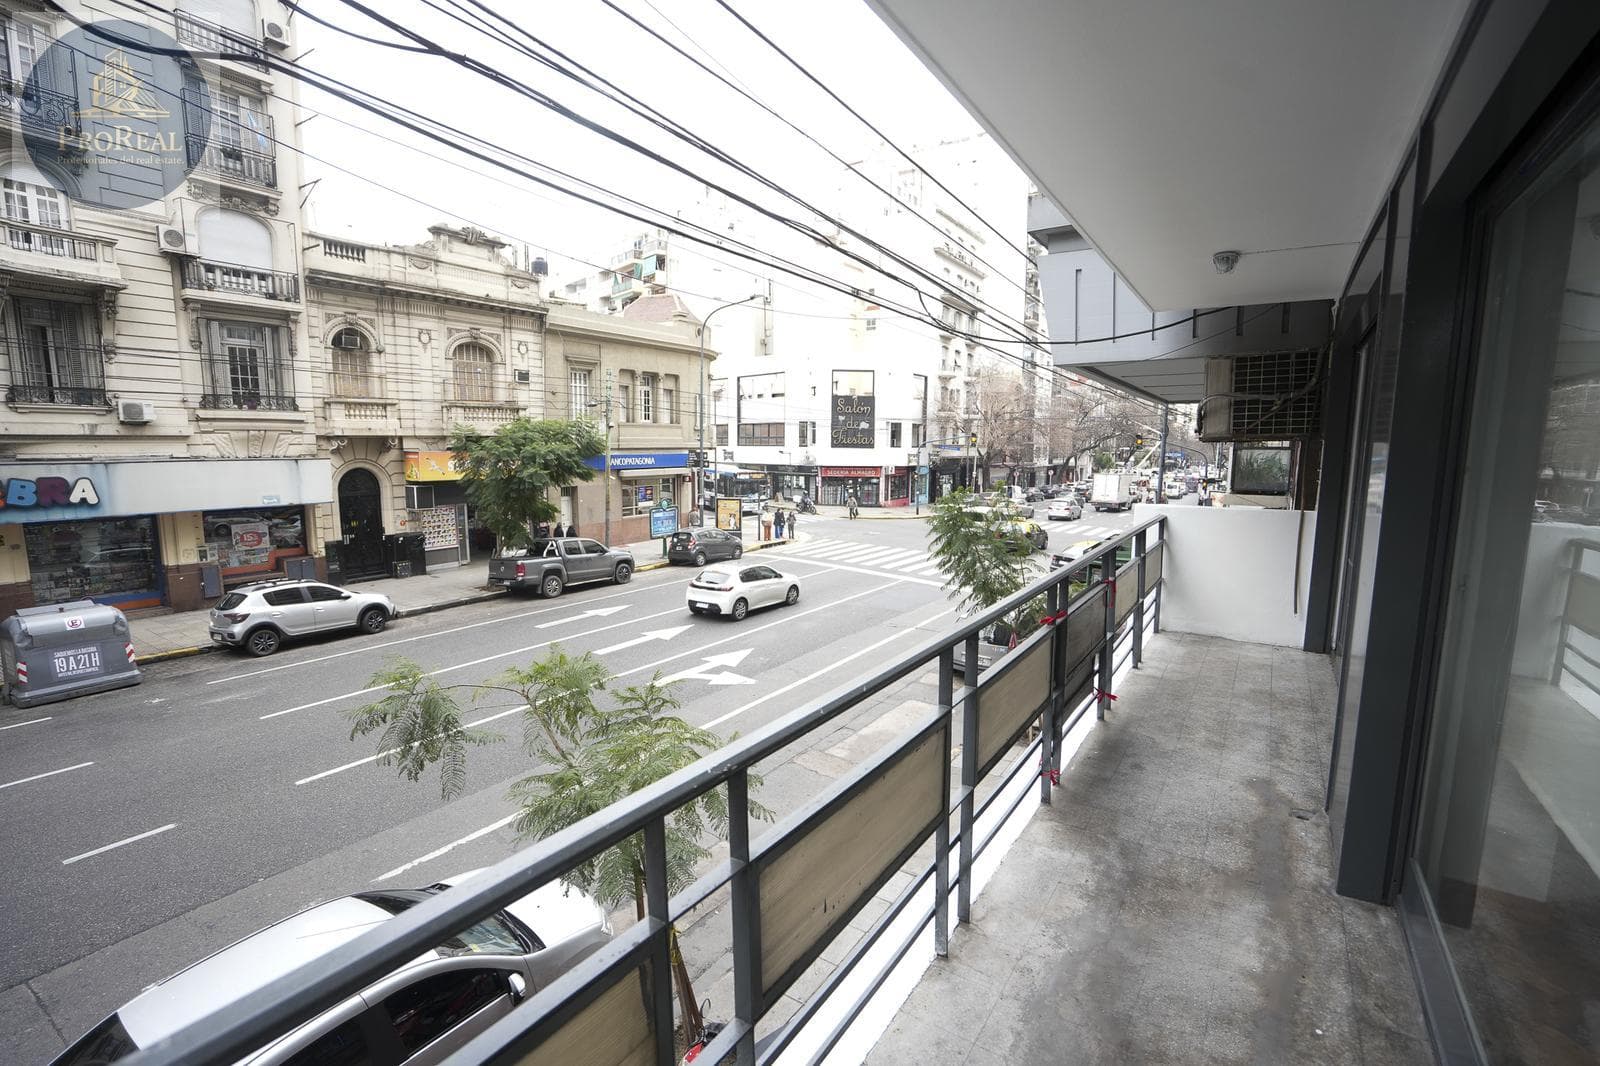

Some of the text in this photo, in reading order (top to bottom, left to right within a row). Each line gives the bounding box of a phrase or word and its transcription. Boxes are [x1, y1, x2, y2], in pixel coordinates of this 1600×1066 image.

[846, 416, 860, 429] de
[832, 426, 874, 444] Fiestas
[609, 457, 656, 466] ANCOPATAGONIA
[53, 657, 67, 673] 19
[69, 656, 77, 671] A
[77, 653, 90, 670] 21
[91, 652, 100, 667] H
